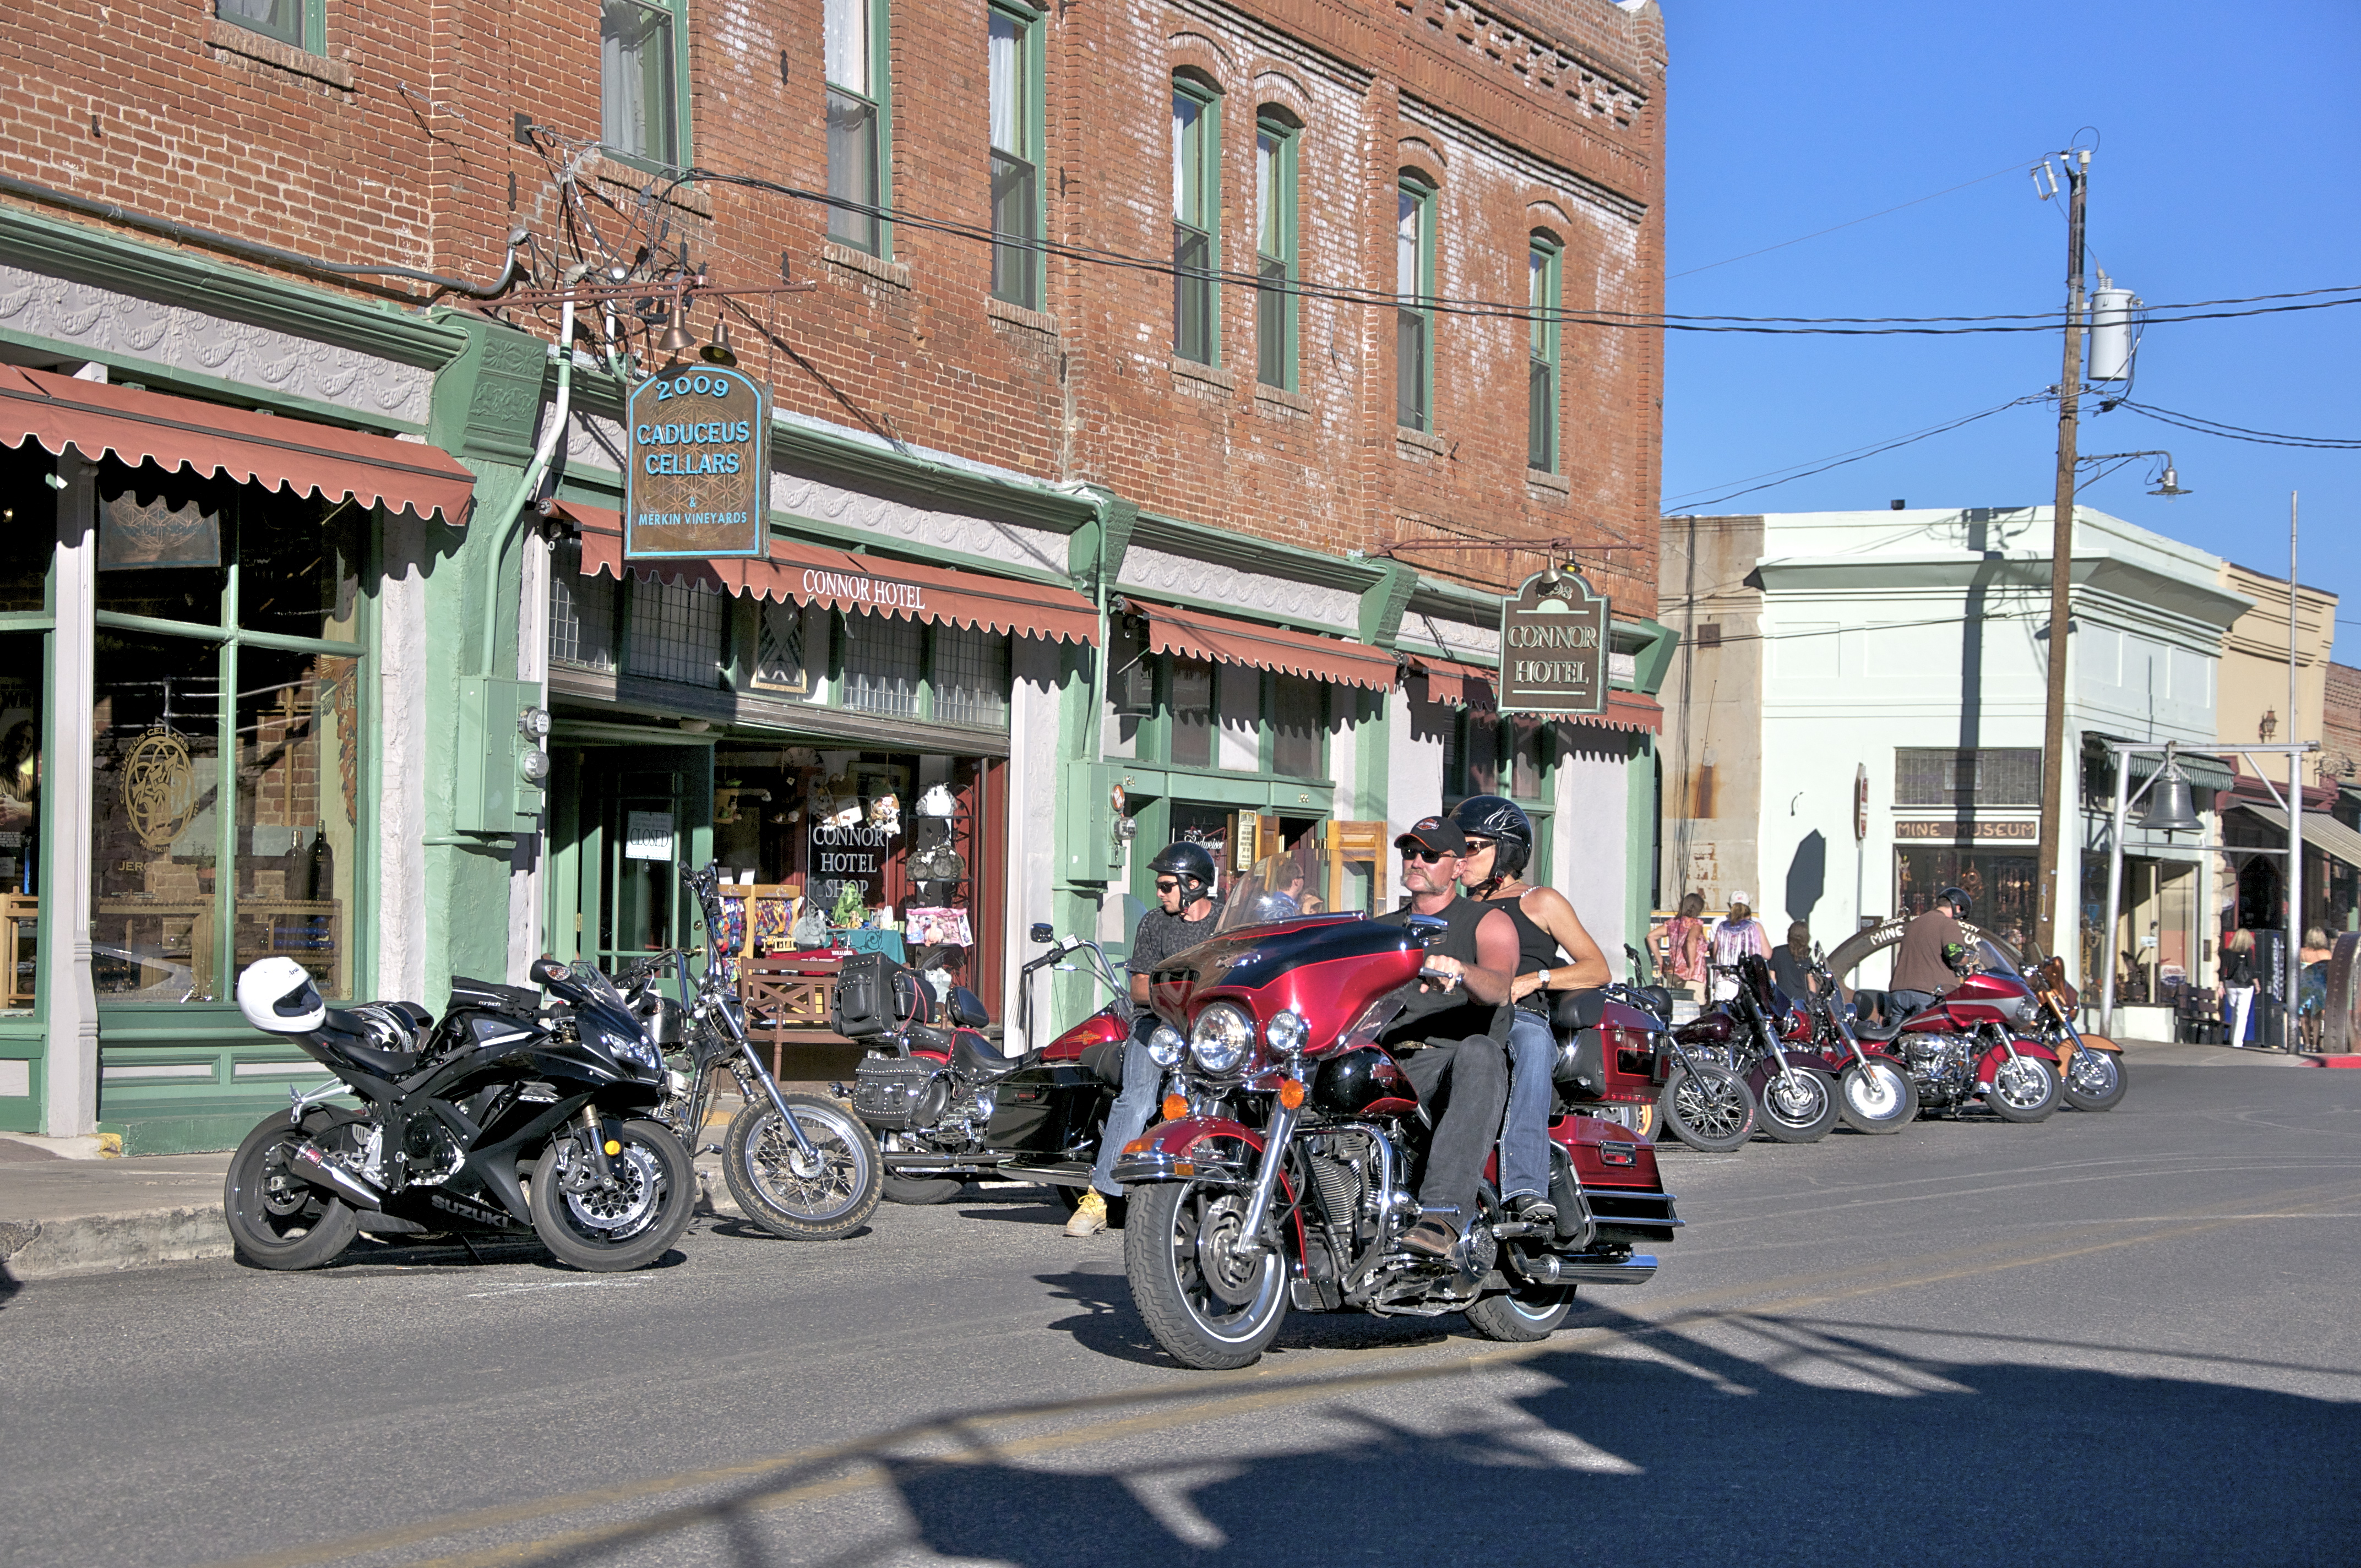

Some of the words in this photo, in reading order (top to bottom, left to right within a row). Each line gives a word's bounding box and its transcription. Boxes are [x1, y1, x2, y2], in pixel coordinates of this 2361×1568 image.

[656, 375, 730, 401] 2009
[637, 421, 750, 445] CADUCEUS
[645, 453, 740, 475] CELLARS
[689, 497, 697, 508] &
[639, 514, 681, 525] MERKIN
[684, 511, 747, 524] VINEYARDS
[803, 569, 871, 601] CONNOR
[874, 580, 926, 609] HOTEL
[1508, 625, 1599, 649] CONNOR
[1514, 660, 1589, 684] HOTEL
[119, 733, 146, 804] CADUCEUS
[630, 827, 668, 847] CLOSED
[813, 826, 885, 846] CONNOR
[1897, 823, 1941, 836] MINE
[1956, 823, 2034, 836] MUSEUM
[820, 853, 877, 872] HOTEL
[826, 879, 868, 898] SHOP
[1870, 925, 1905, 945] MINE
[289, 967, 300, 978] Arai
[432, 1195, 509, 1228] SUZUKI
